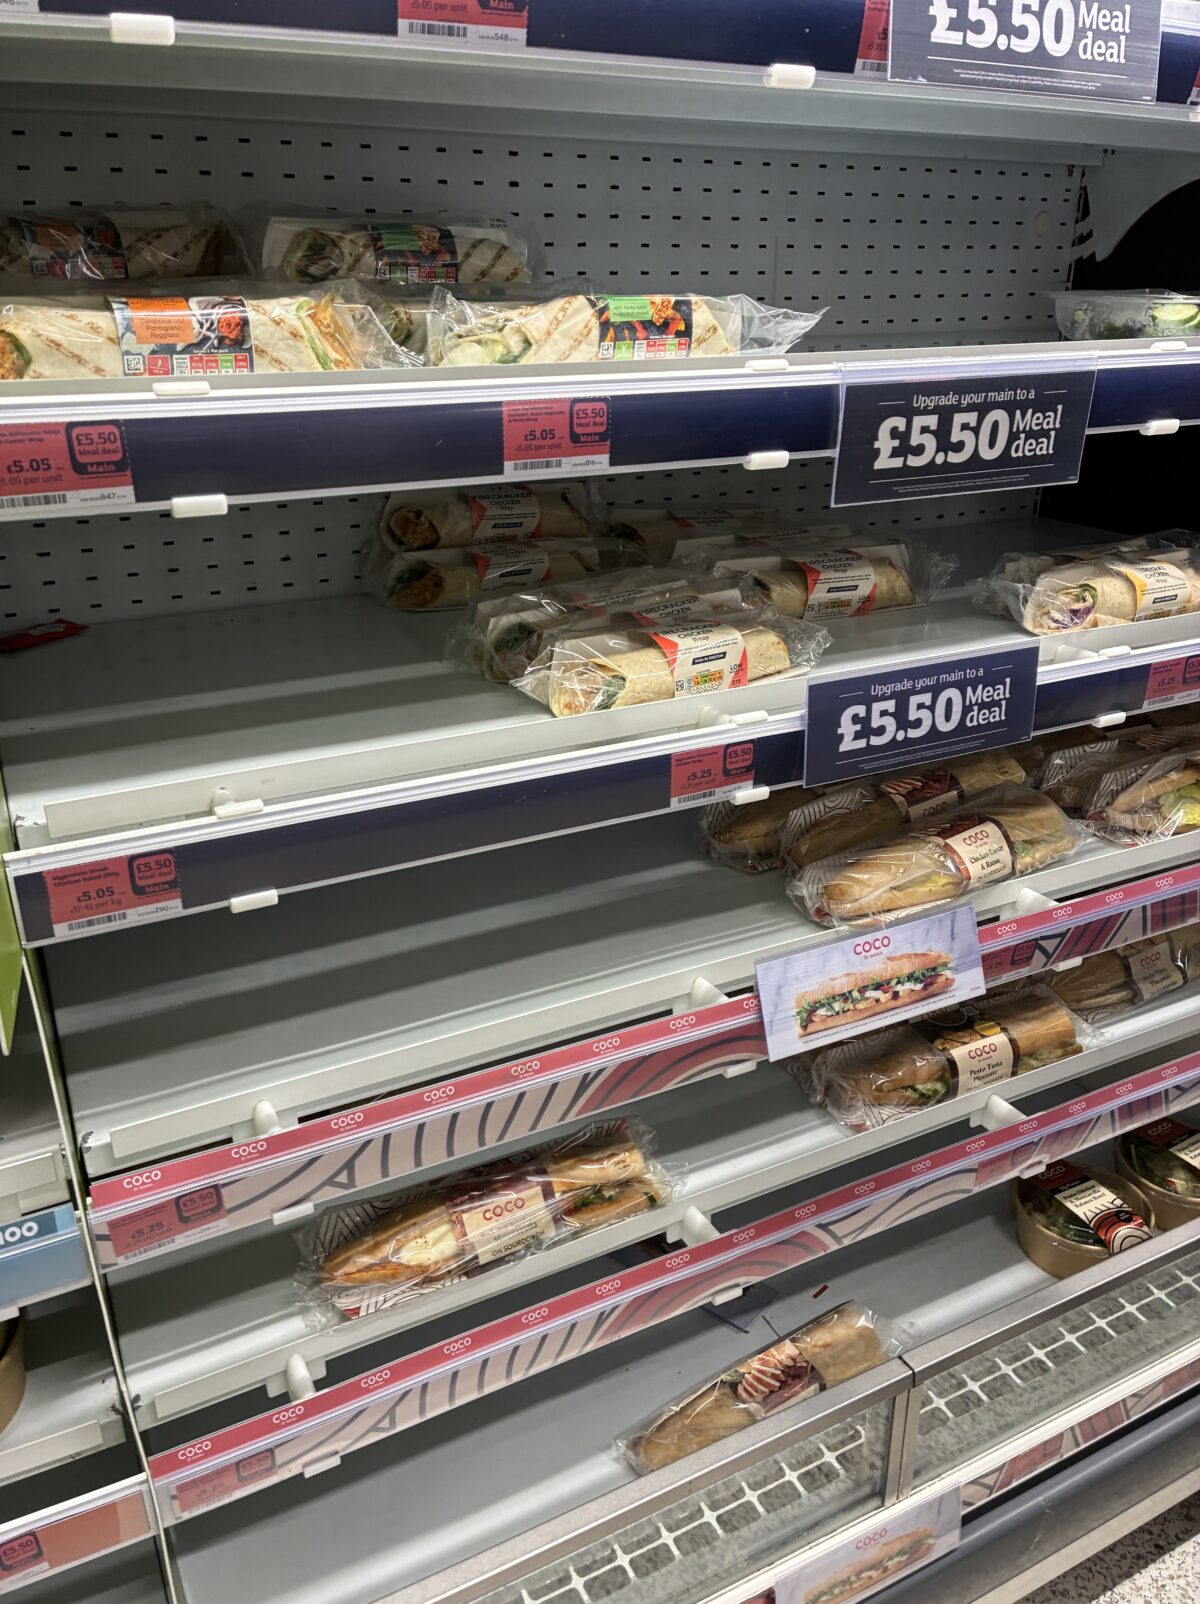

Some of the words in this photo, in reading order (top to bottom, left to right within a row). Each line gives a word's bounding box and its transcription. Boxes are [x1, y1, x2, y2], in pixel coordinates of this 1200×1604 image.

[928, 0, 1076, 57] £5.50
[1079, 0, 1131, 34] Meal
[494, 32, 509, 42] 548
[1078, 31, 1127, 64] deal
[913, 391, 959, 409] Upgrade
[961, 392, 986, 408] your
[987, 389, 1015, 403] main
[1016, 389, 1027, 400] to
[1028, 390, 1035, 400] a
[575, 408, 605, 420] £5.50
[75, 432, 117, 446] £5.50
[524, 428, 556, 441] £5.05
[873, 408, 1010, 470] £5.50
[1012, 405, 1063, 432] Meal
[101, 447, 120, 455] deal
[1011, 431, 1054, 458] deal
[6, 458, 52, 474] £5.05
[87, 463, 116, 473] Main
[0, 477, 22, 487] 5.05
[23, 476, 40, 486] per
[42, 474, 63, 484] unit
[821, 562, 854, 570] CHICKEN
[637, 597, 700, 616] FIRECRACKER
[659, 606, 692, 619] CHICKEN
[655, 622, 723, 637] FIRECRACKER
[677, 628, 714, 640] CHICKEN
[729, 663, 743, 671] LOW
[871, 678, 914, 697] Upgrade
[914, 676, 937, 691] your
[939, 671, 965, 684] main
[966, 669, 977, 679] to
[976, 669, 984, 678] a
[837, 687, 963, 752] £5.50
[965, 677, 1011, 706] Meal
[965, 701, 1006, 727] deal
[728, 747, 752, 759] £5.50
[687, 768, 712, 782] £5.25
[922, 801, 949, 817] COCO
[962, 829, 990, 847] COCO
[135, 857, 172, 874] £5.50
[969, 851, 990, 865] Chicken
[137, 873, 156, 881] Meal
[157, 870, 174, 879] deal
[1155, 877, 1174, 888] COCO
[76, 886, 115, 903] £5.05
[144, 883, 170, 893] Main
[95, 901, 109, 911] per
[110, 898, 122, 908] kg
[1105, 891, 1124, 903] COCO
[1052, 907, 1072, 919] COCO
[997, 922, 1018, 935] COCO
[853, 935, 891, 956] COCO
[869, 950, 884, 958] MAMA
[1140, 951, 1161, 968] COCO
[669, 1015, 696, 1030] COCO
[592, 1037, 621, 1052] COCO
[968, 1042, 998, 1060] COCO
[511, 1060, 541, 1076] COCO
[969, 1065, 987, 1077] Pesto
[987, 1059, 1003, 1070] Tuna
[1161, 1065, 1178, 1078] COCO
[973, 1069, 998, 1083] Piccante
[423, 1085, 455, 1102] COCO
[1115, 1083, 1133, 1095] COCO
[1068, 1101, 1086, 1114] COCO
[330, 1112, 365, 1129] COCO
[1018, 1120, 1038, 1132] COCO
[231, 1141, 267, 1159] COCO
[966, 1139, 986, 1152] COCO
[911, 1160, 932, 1173] COCO
[1038, 1165, 1066, 1180] COCO
[123, 1170, 162, 1189] COCO
[854, 1181, 876, 1195] COCO
[182, 1191, 214, 1209] £5.50
[482, 1197, 525, 1221] COCO
[795, 1204, 817, 1218] COCO
[131, 1221, 165, 1240] £5.25
[732, 1228, 756, 1243] COCO
[491, 1248, 503, 1257] ON
[503, 1229, 546, 1253] SOURDOUGH
[665, 1253, 691, 1269] COCO
[595, 1279, 622, 1296] COCO
[521, 1307, 549, 1324] COCO
[443, 1337, 472, 1355] COCO
[360, 1369, 391, 1388] COCO
[272, 1405, 305, 1424] COCO
[177, 1440, 212, 1461] COCO
[855, 1527, 888, 1551] COCO
